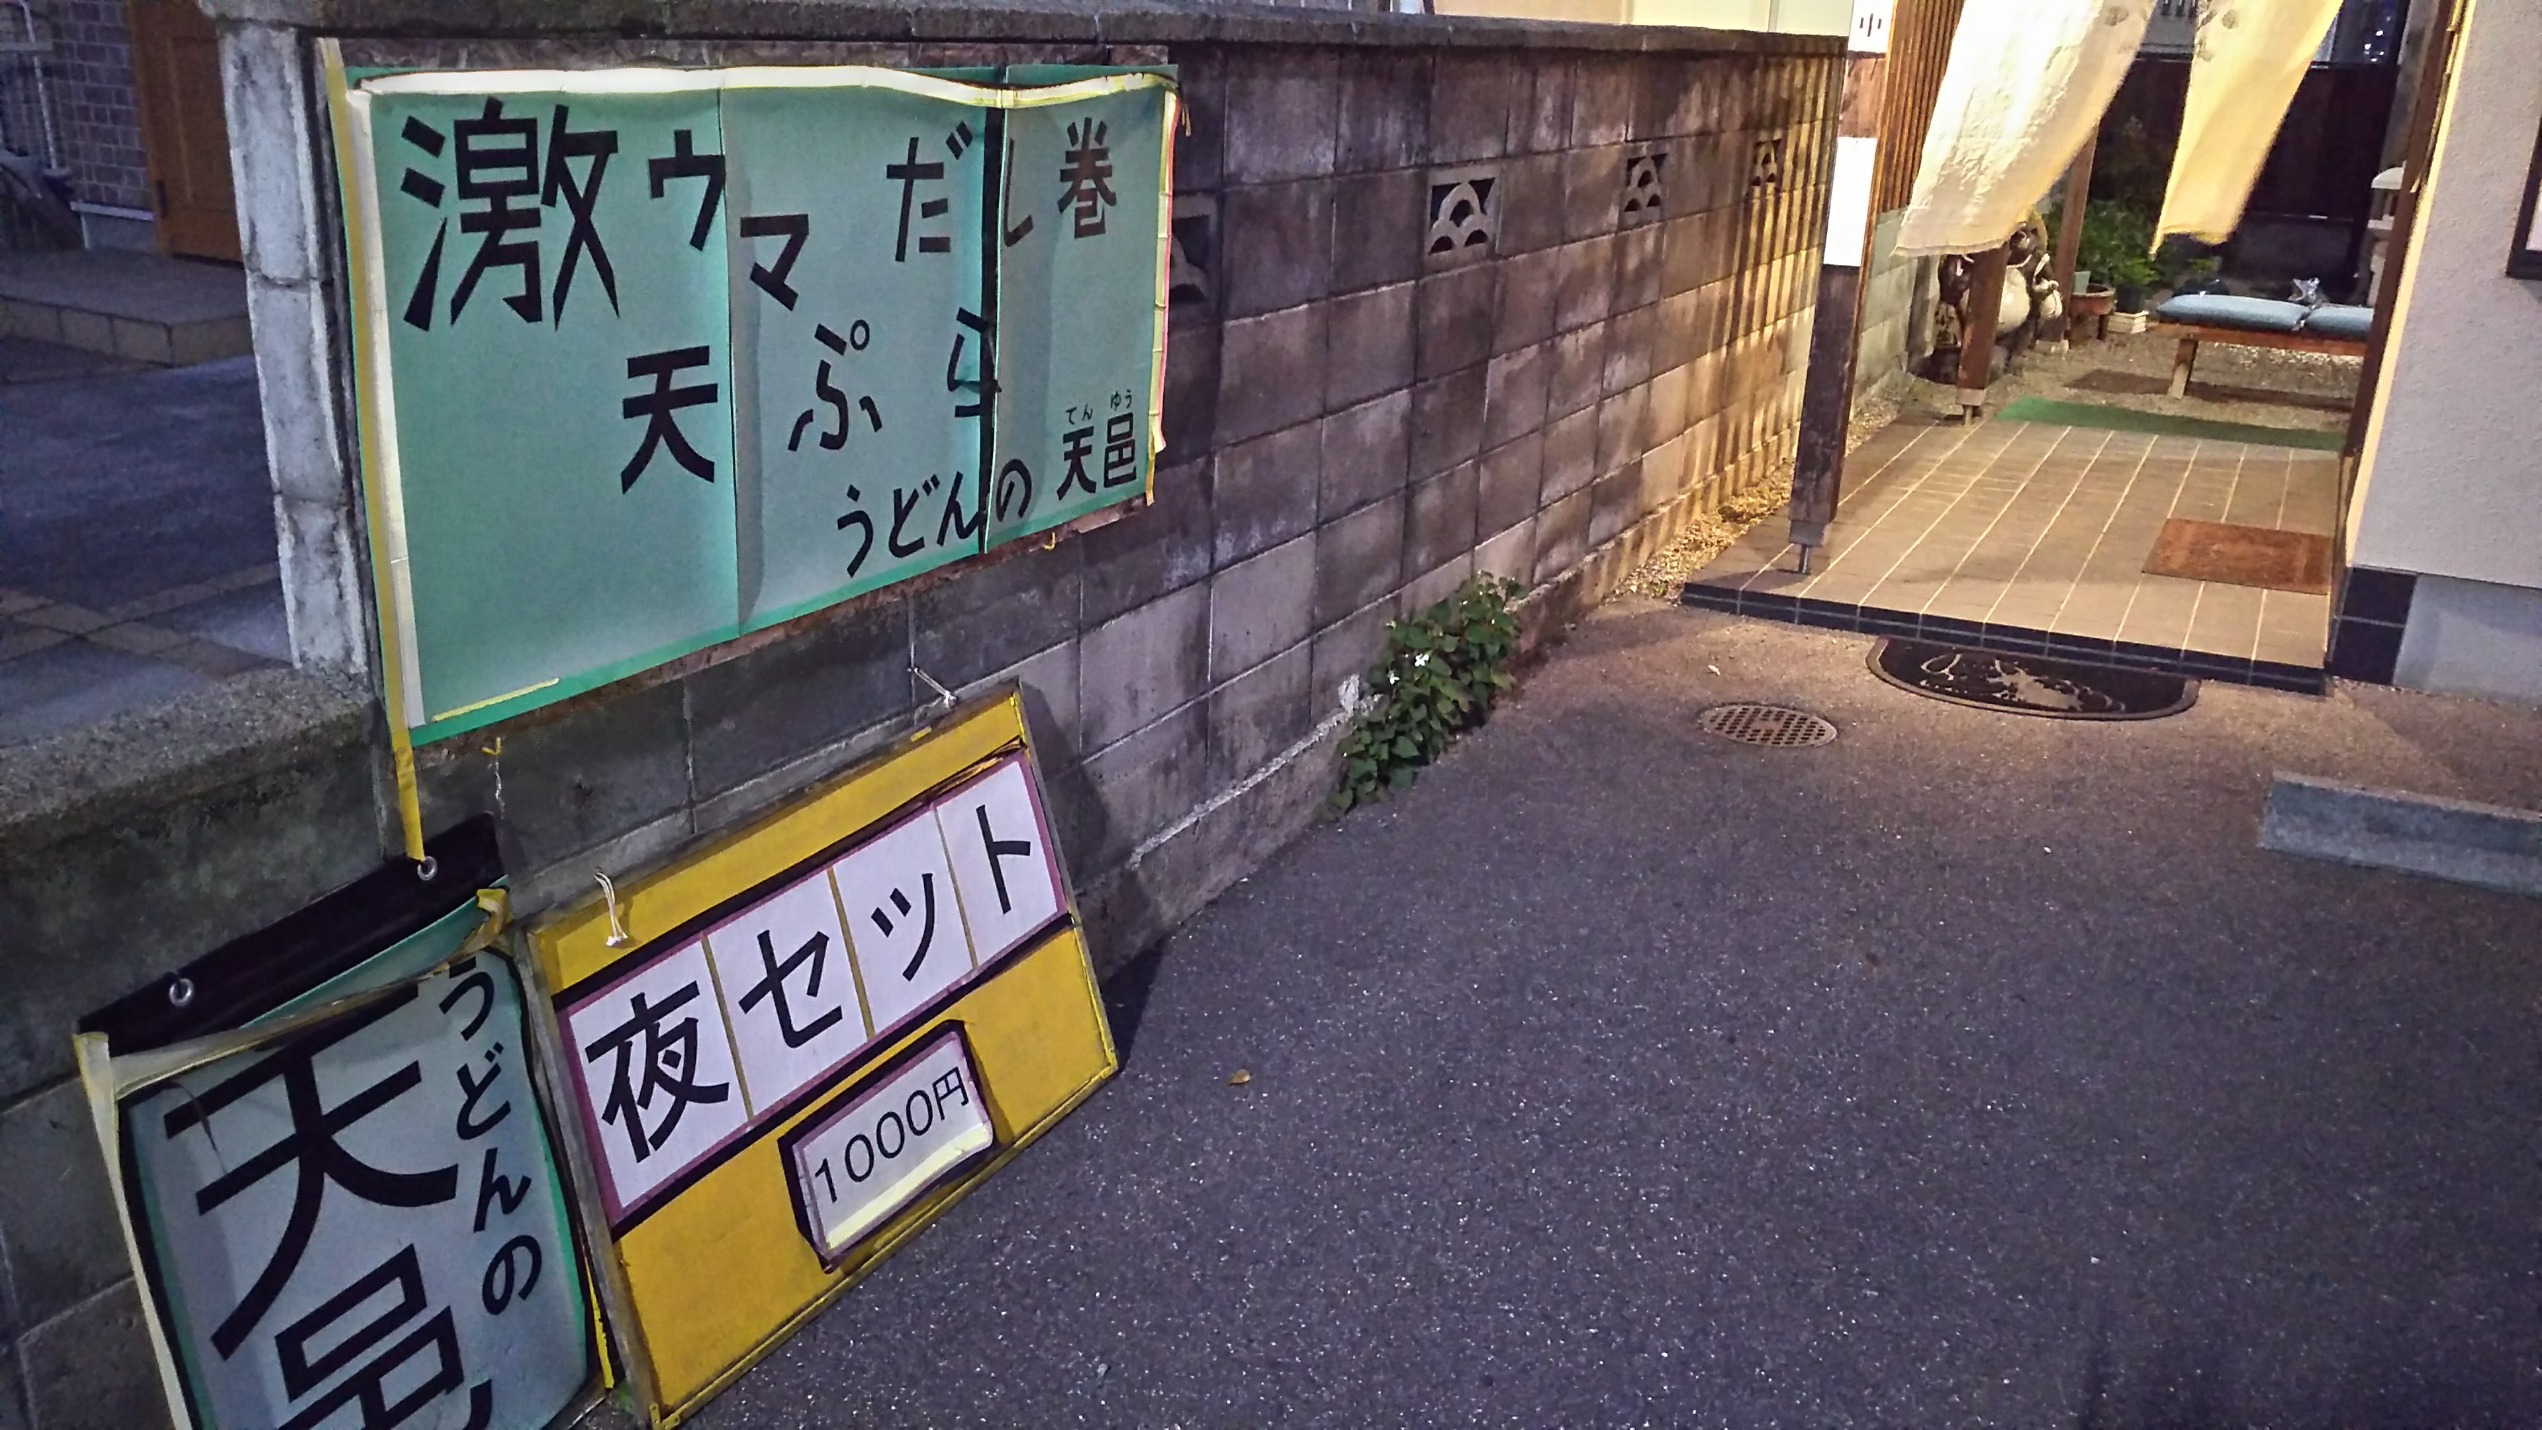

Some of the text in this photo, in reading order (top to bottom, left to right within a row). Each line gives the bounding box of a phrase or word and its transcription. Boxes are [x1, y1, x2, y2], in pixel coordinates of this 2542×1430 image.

[401, 97, 1117, 331] 激ウマ だし巻
[1066, 404, 1093, 425] てん
[585, 804, 1031, 1163] 夜セット
[814, 1066, 971, 1203] 1000円
